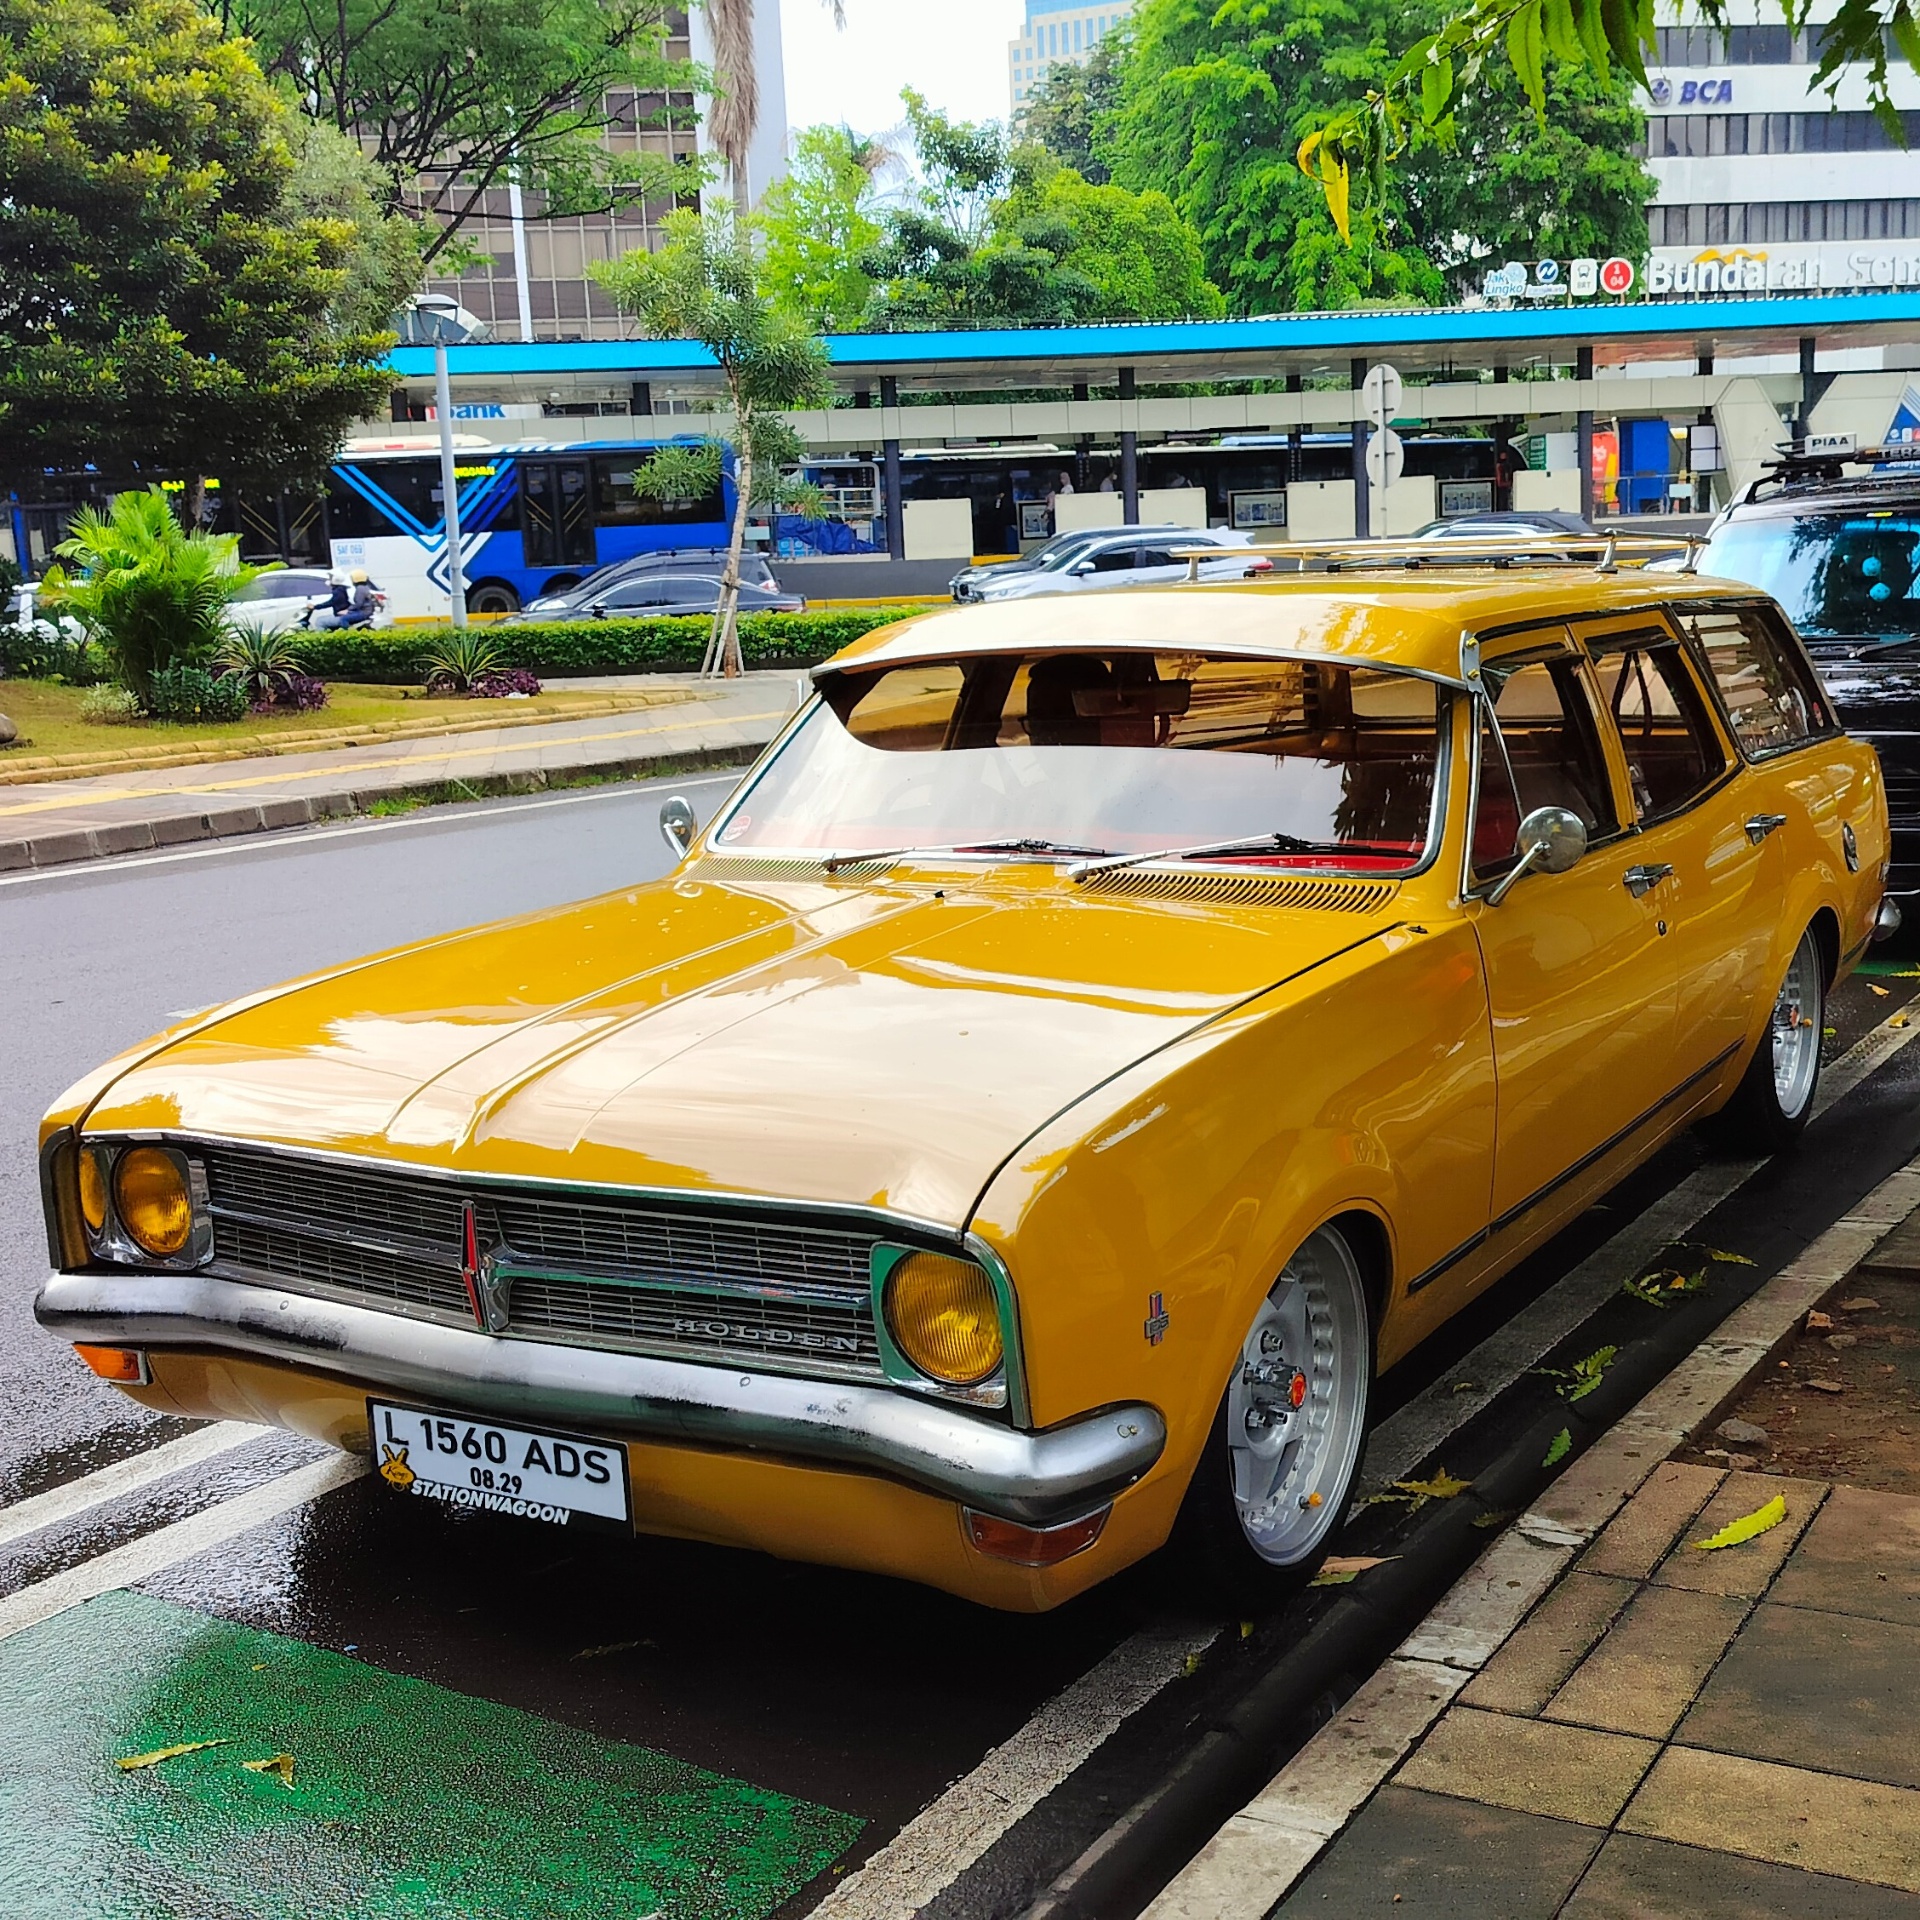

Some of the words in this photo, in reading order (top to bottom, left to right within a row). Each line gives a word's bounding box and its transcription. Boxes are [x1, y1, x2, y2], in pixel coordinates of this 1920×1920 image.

[1679, 79, 1732, 104] BCA
[1485, 272, 1505, 284] Jak
[1610, 275, 1624, 287] 04
[1650, 255, 1826, 293] Bundaran
[1485, 283, 1523, 297] Lingko
[1811, 436, 1849, 447] PIAA
[673, 1318, 861, 1351] HOLDEN
[384, 1411, 409, 1446] L
[419, 1418, 507, 1465] 1560
[522, 1439, 611, 1484] ADS
[470, 1466, 523, 1495] 08.29
[411, 1478, 571, 1526] STATIONWAGOON
